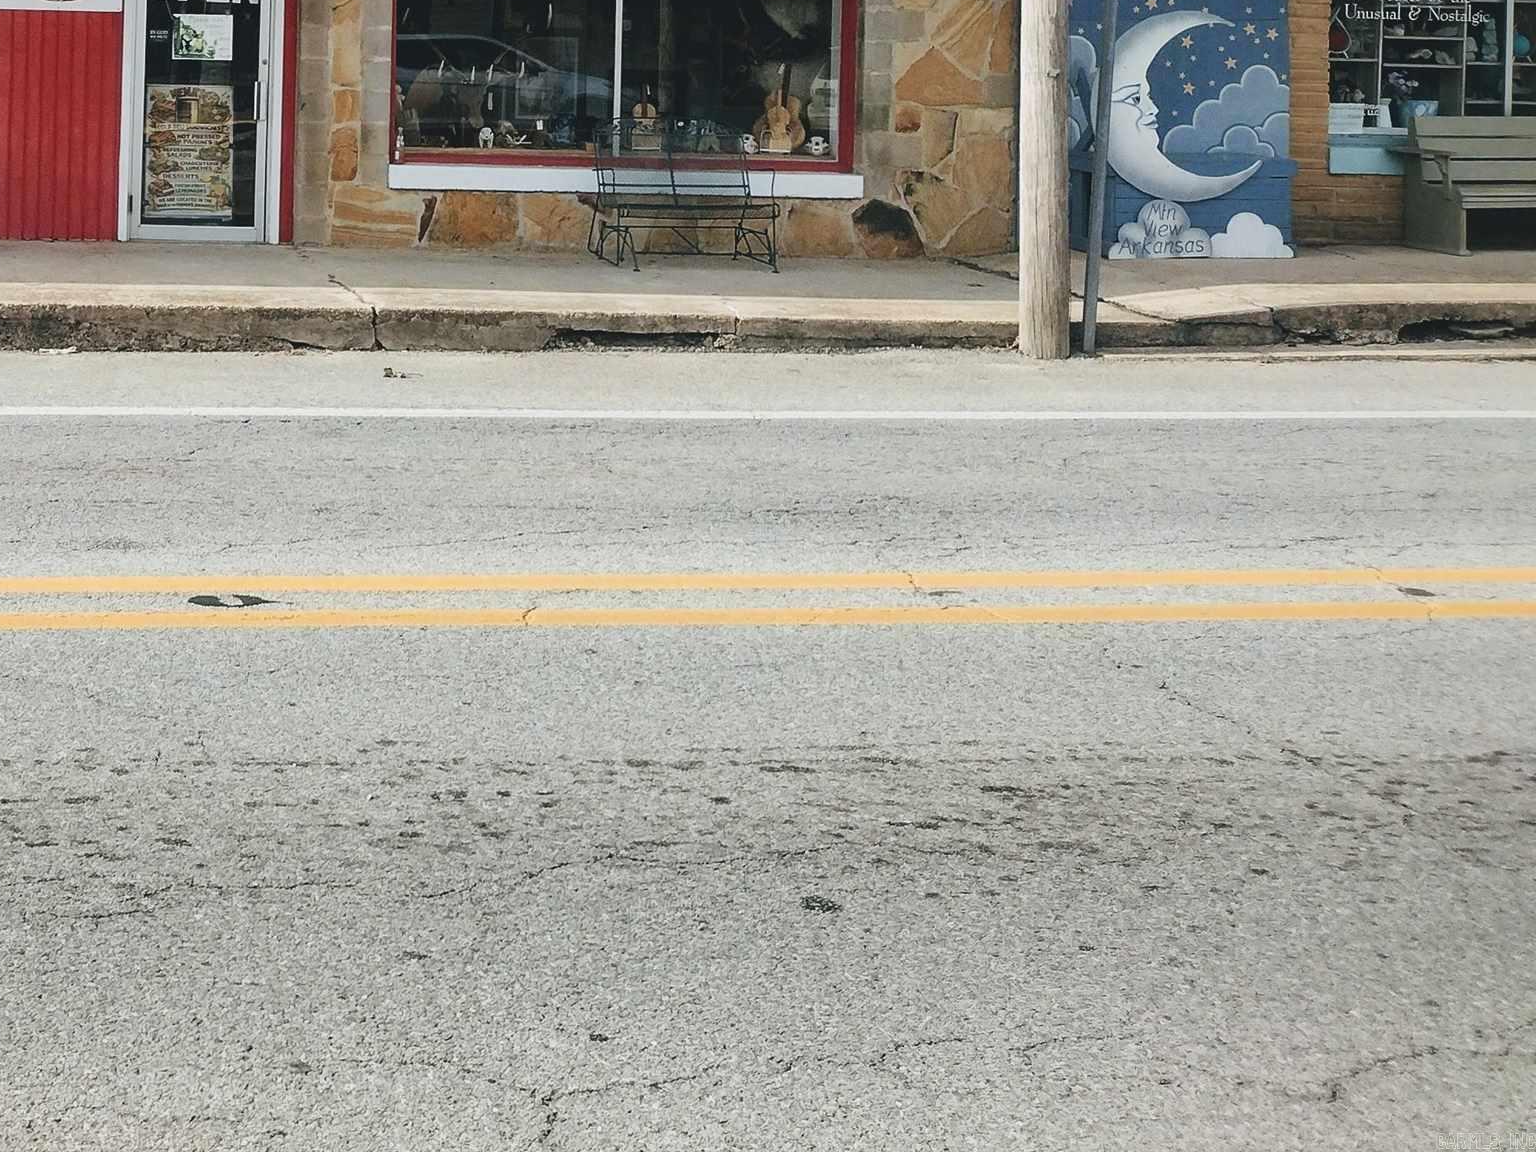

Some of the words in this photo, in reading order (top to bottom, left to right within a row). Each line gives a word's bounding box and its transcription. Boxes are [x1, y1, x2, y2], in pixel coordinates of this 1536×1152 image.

[1345, 3, 1401, 20] Unusual
[1408, 5, 1422, 21] &
[1428, 4, 1491, 27] Nostalgic
[1147, 203, 1177, 221] Mtn
[1144, 219, 1183, 238] View
[1118, 237, 1205, 255] Arkansas
